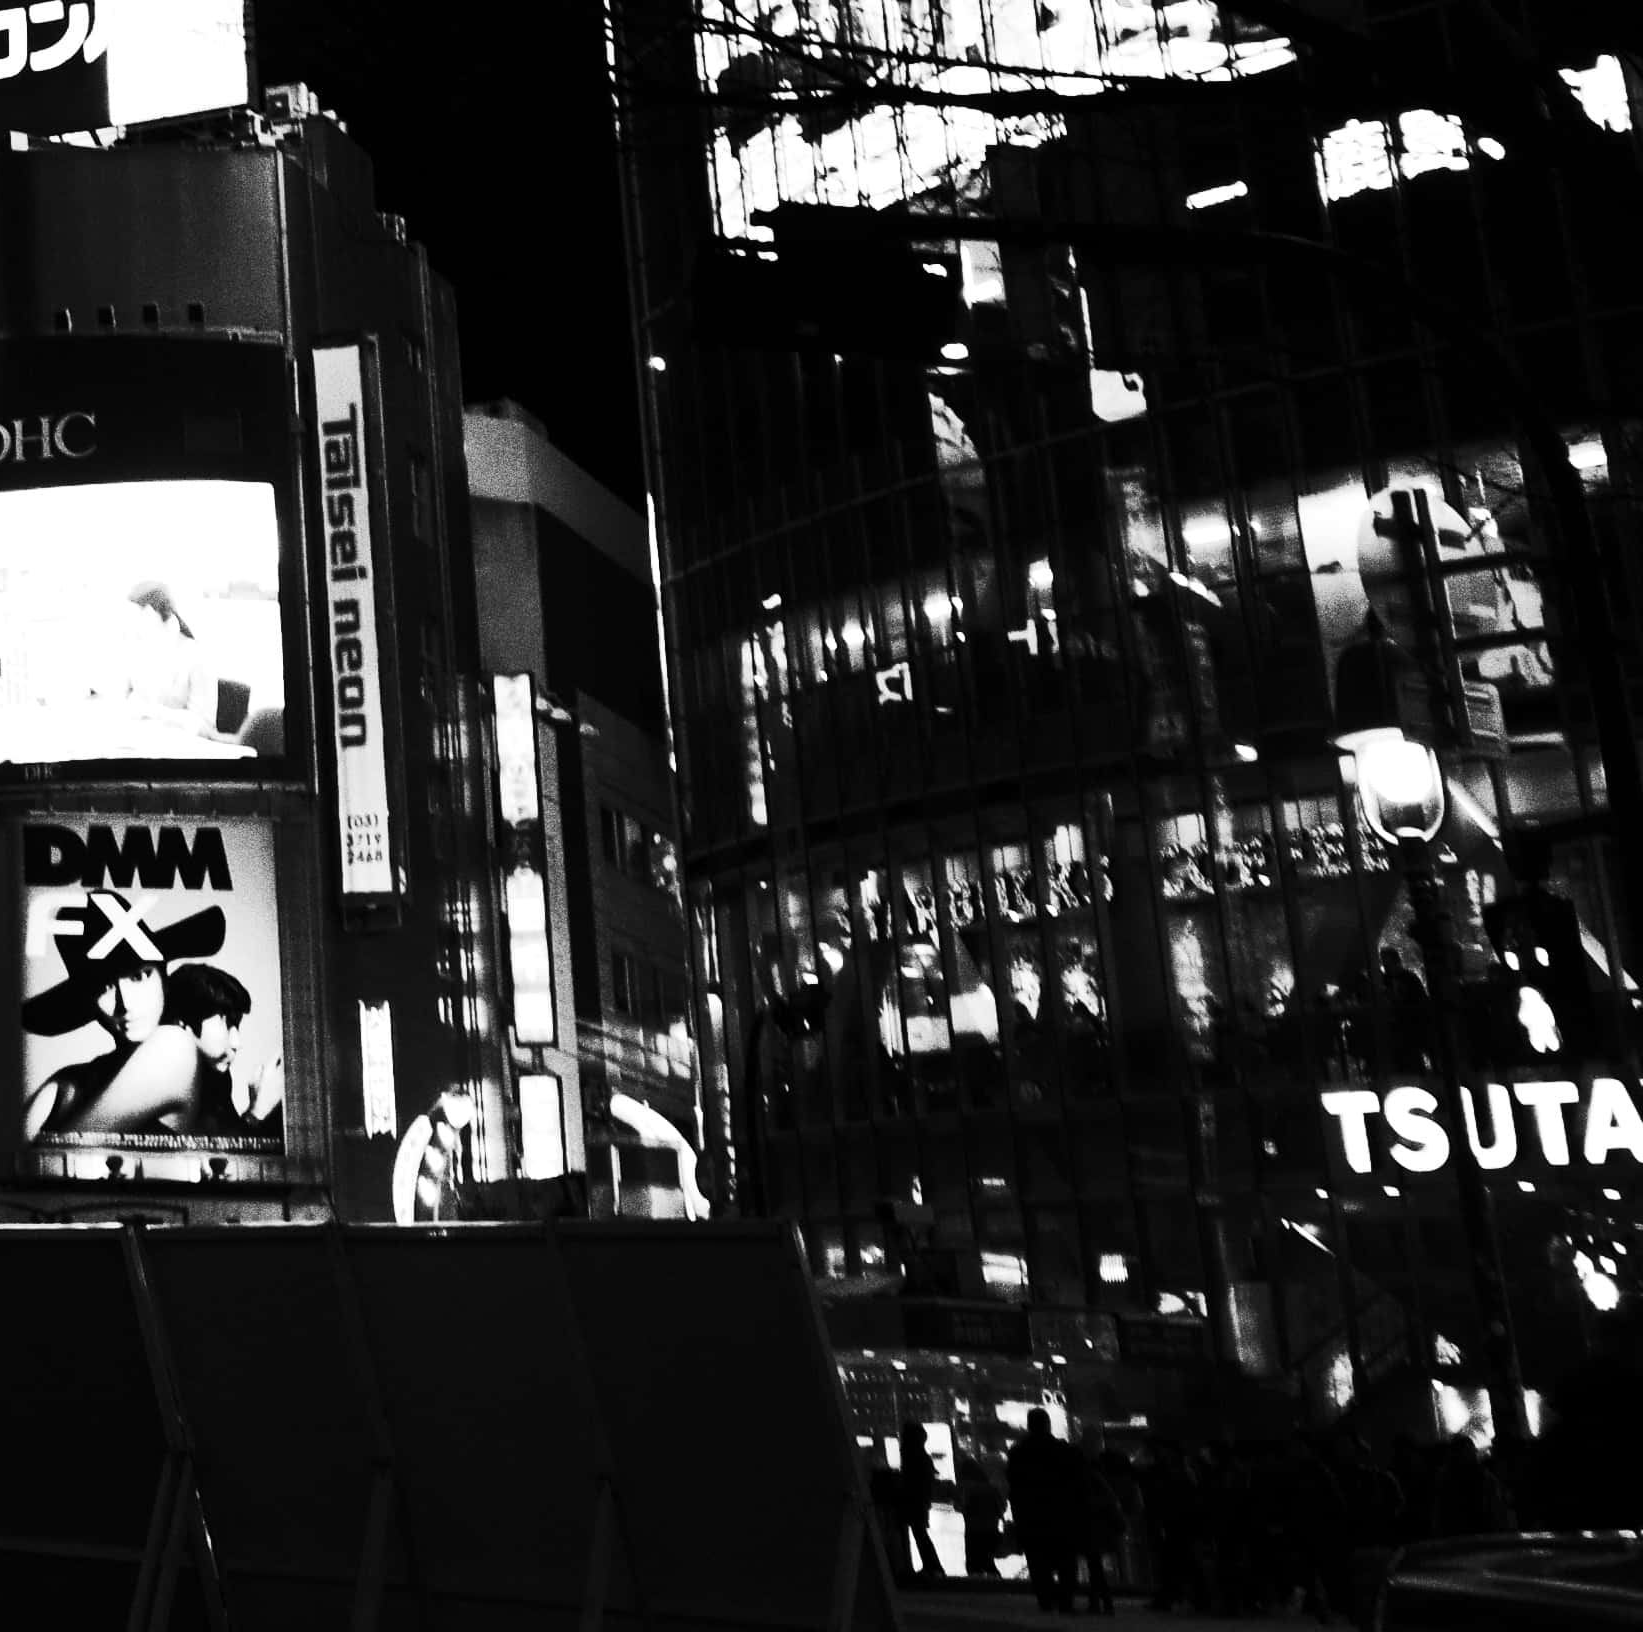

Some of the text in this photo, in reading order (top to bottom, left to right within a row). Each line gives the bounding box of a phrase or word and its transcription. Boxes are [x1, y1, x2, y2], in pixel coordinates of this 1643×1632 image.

[321, 401, 371, 748] Taisei neon
[23, 824, 234, 891] DMM
[25, 893, 165, 961] FX
[1319, 1076, 1643, 1174] TSUTA
